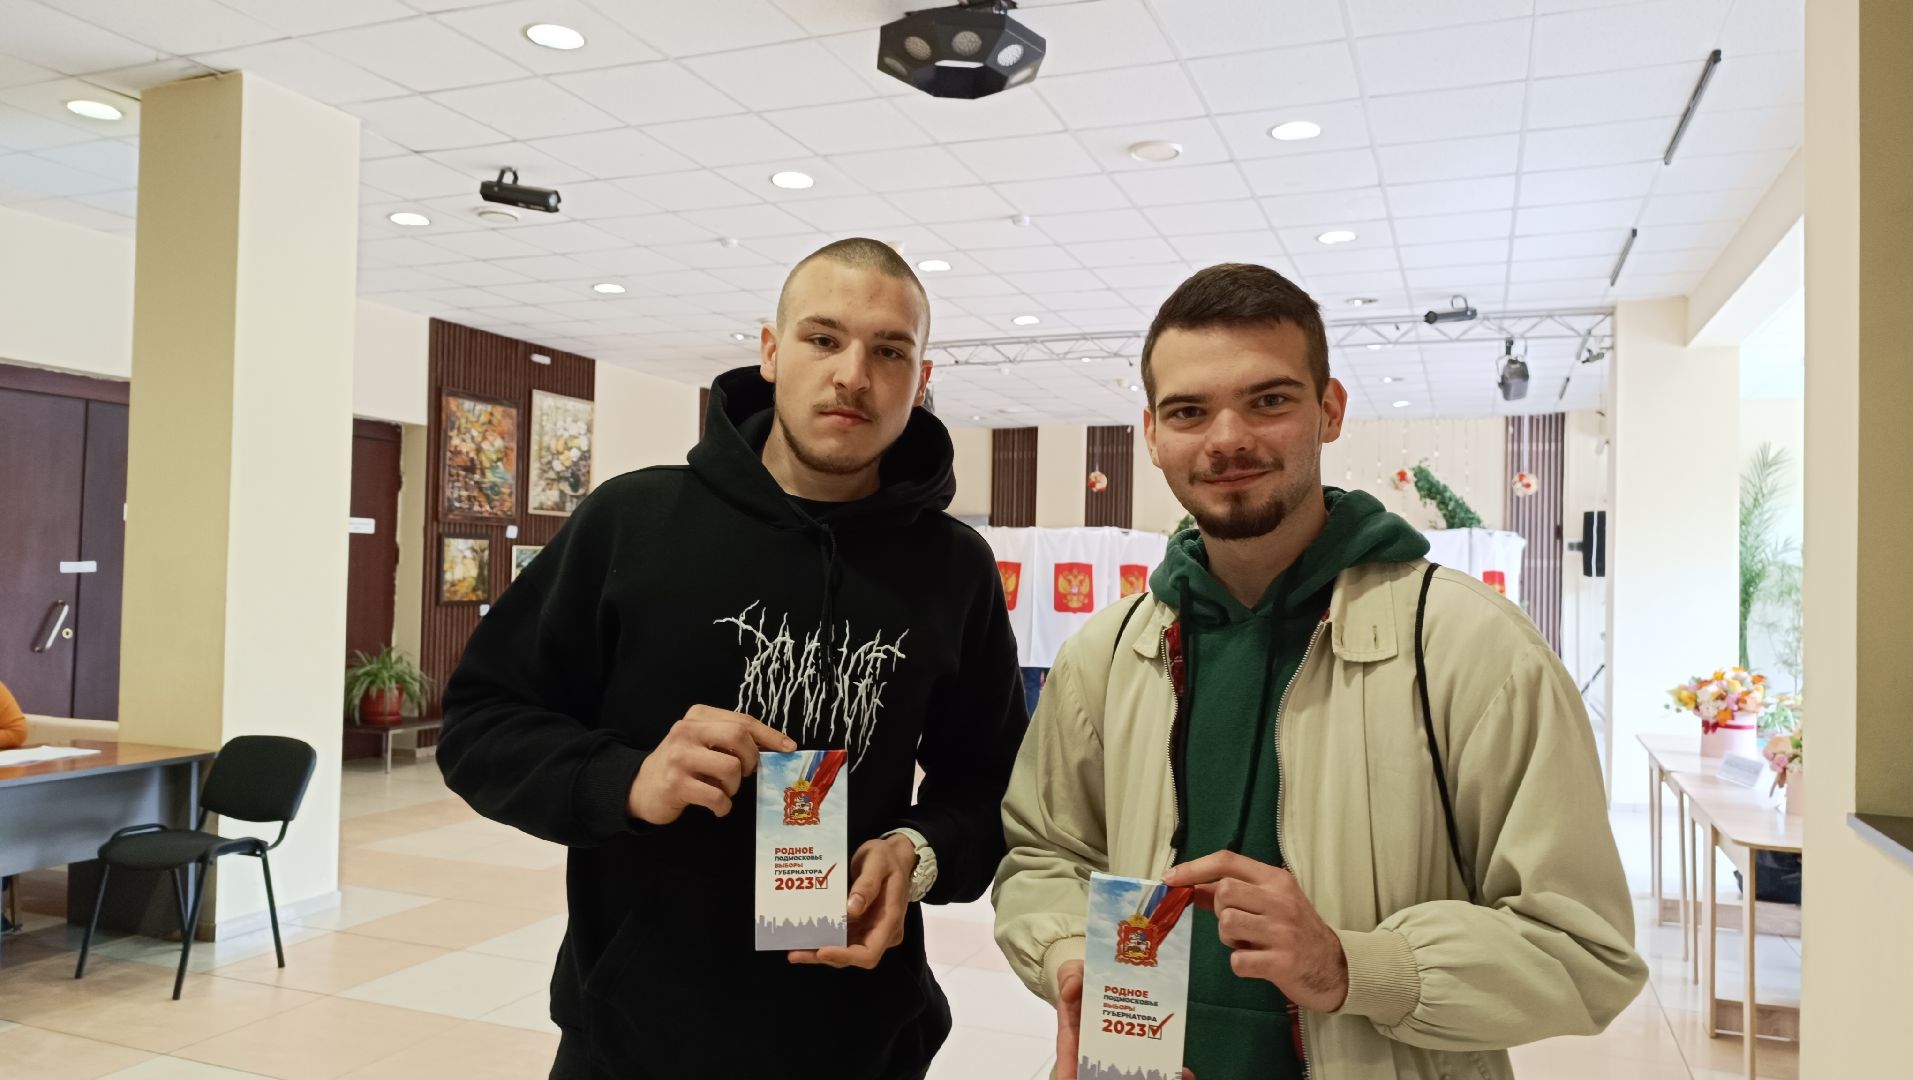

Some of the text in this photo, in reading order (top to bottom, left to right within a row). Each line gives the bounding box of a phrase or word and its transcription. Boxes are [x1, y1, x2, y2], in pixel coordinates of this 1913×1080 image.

[774, 846, 814, 855] РОДНОЕ
[774, 877, 814, 890] 2023
[1104, 985, 1149, 998] РОДНОЕ
[1103, 994, 1159, 1007] ПОДМОСКОВЬЕ
[1103, 1002, 1136, 1012] ВЫБОРЫ
[1102, 1009, 1158, 1022] ГУБЕРНАТОРА
[1102, 1018, 1147, 1037] 2023
